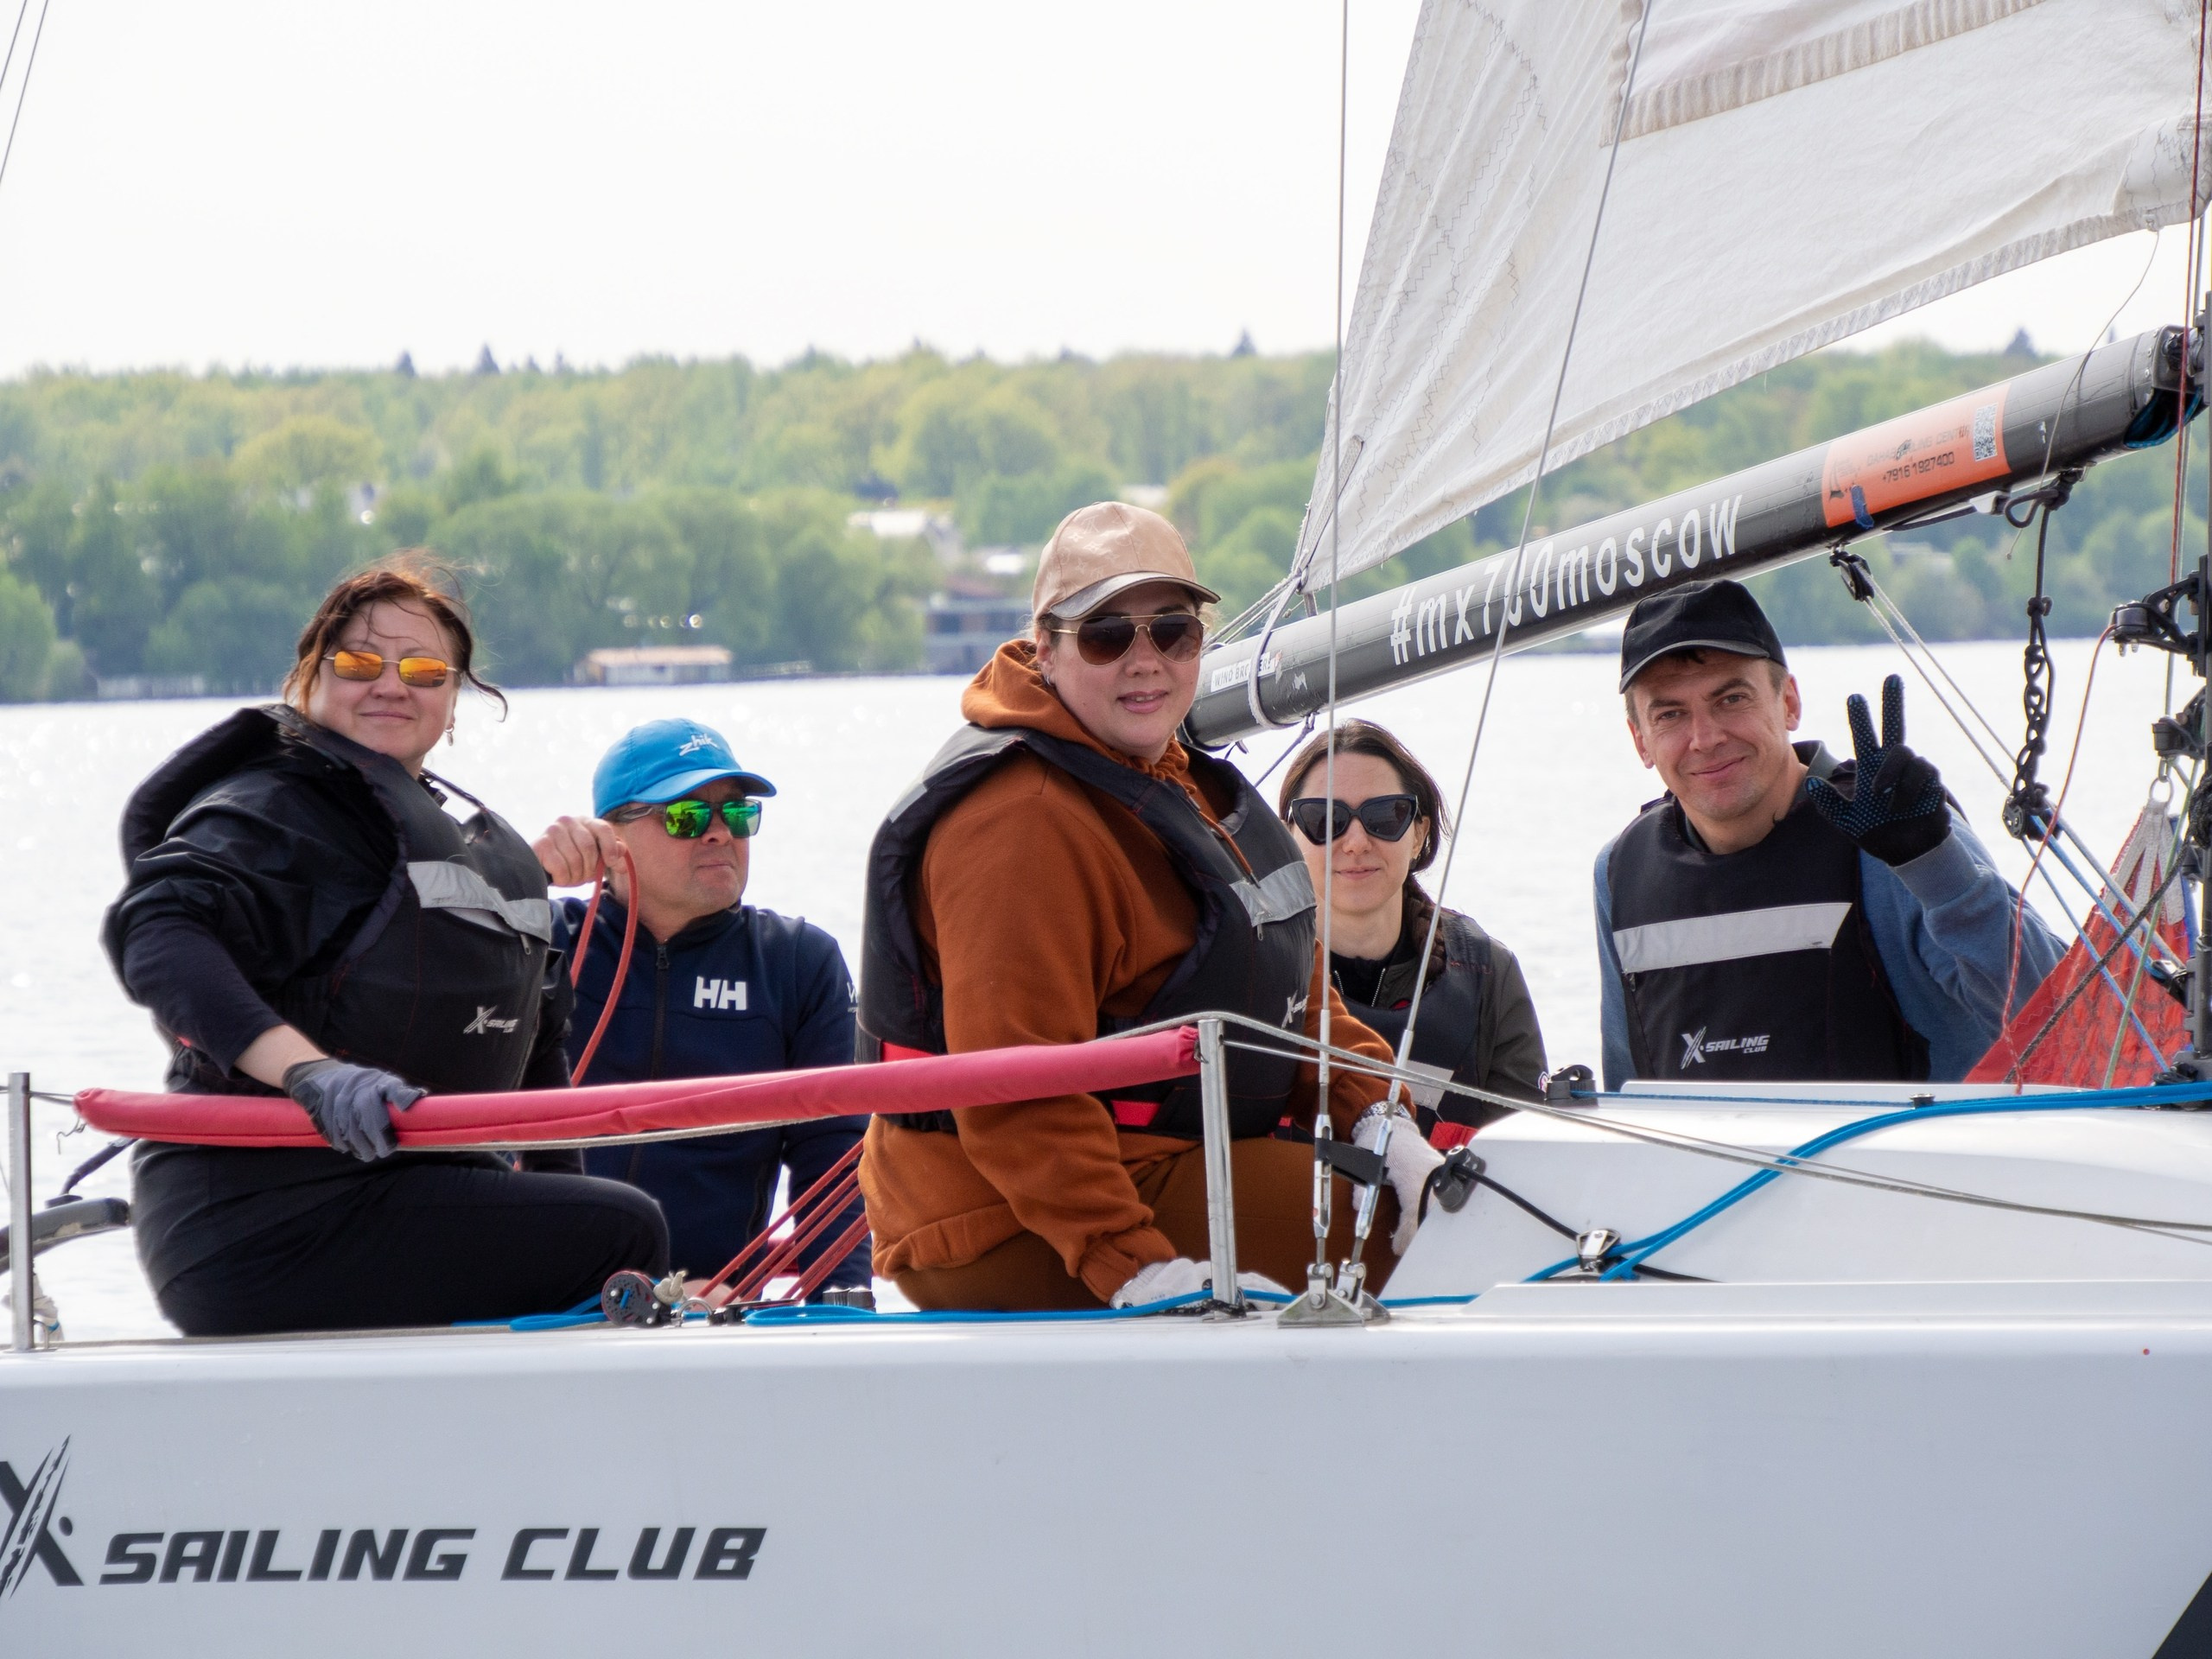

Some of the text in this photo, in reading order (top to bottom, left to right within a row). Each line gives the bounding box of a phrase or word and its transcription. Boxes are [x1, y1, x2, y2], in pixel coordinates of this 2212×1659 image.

[1912, 451, 1955, 474] 1927400
[1389, 494, 1743, 665] #mx700moscow
[693, 976, 747, 1011] HH
[1705, 1034, 1770, 1052] SAILING
[1743, 1046, 1768, 1054] CLUB
[99, 1528, 477, 1586] SAILING
[500, 1527, 768, 1582] CLUB
